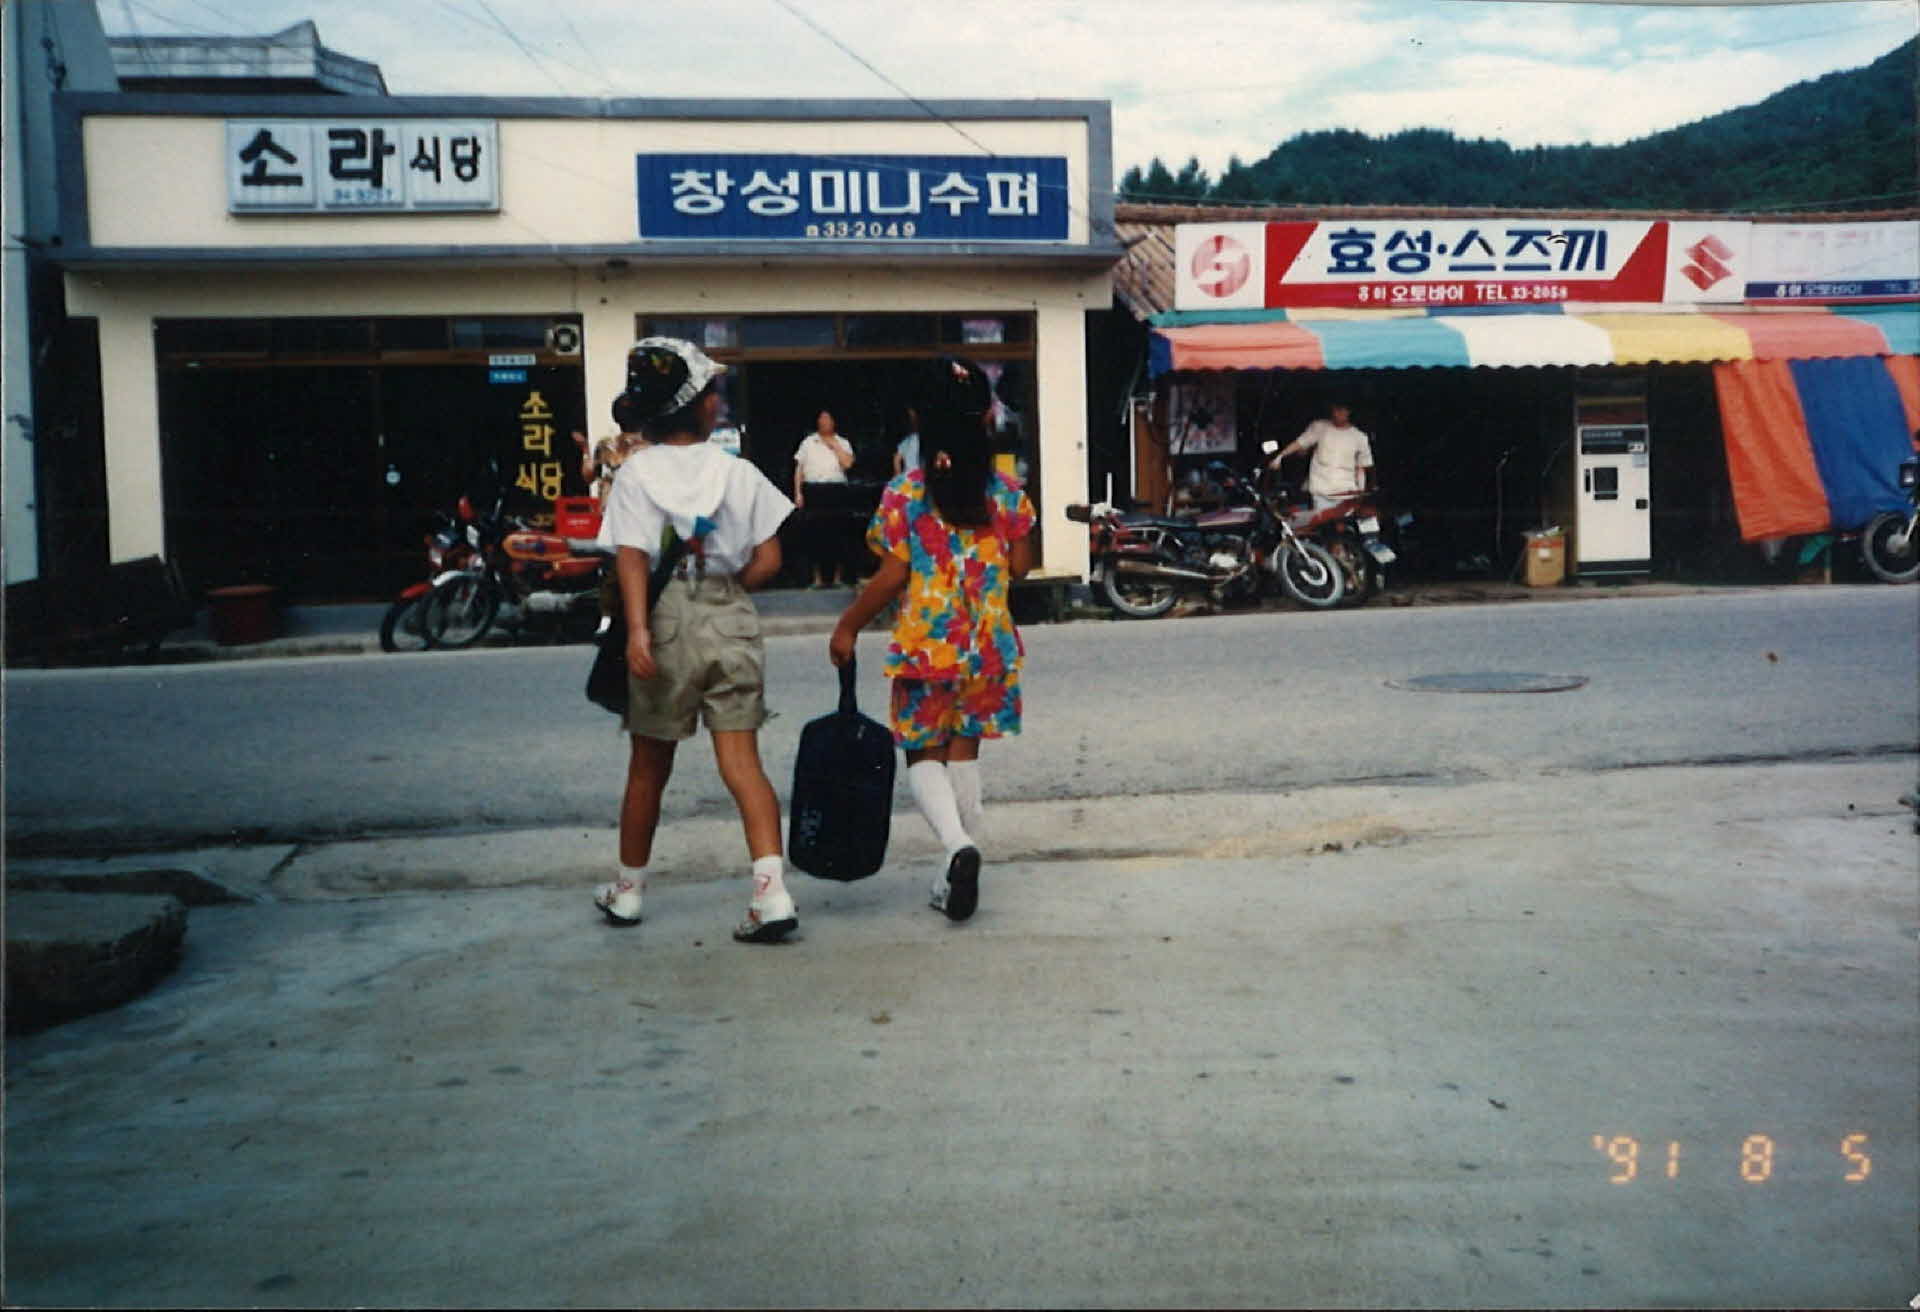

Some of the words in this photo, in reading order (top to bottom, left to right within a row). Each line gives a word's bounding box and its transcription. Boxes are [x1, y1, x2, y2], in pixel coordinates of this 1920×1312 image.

[238, 128, 395, 187] 소라
[410, 136, 481, 183] 식당
[669, 169, 1039, 217] 창성미니수퍼
[1391, 285, 1464, 302] 오토바이
[1474, 284, 1507, 300] TEL
